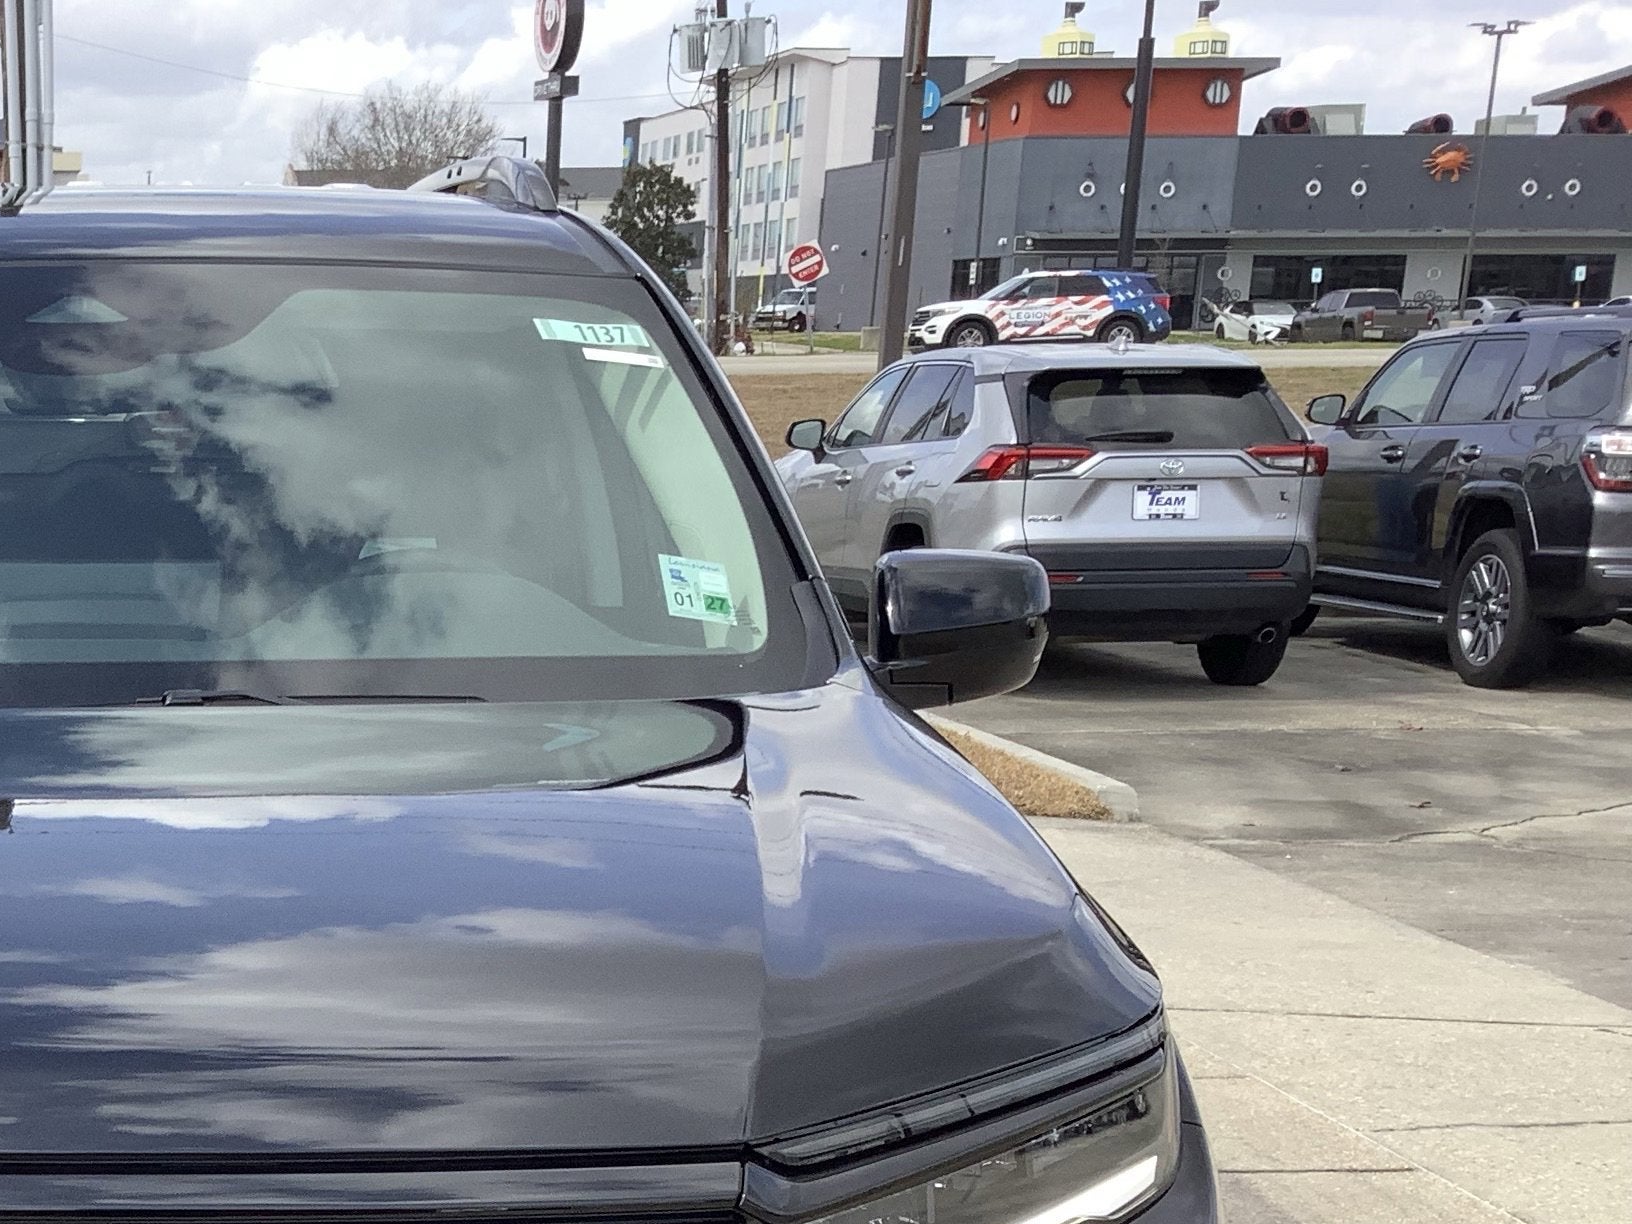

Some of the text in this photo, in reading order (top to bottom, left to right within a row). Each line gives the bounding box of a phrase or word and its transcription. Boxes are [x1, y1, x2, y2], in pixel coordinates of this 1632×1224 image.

[791, 248, 815, 264] DO NOT
[798, 264, 820, 278] ENTER
[1008, 311, 1051, 320] LEGION
[573, 324, 625, 343] 1137
[1148, 490, 1186, 506] TEAM
[674, 592, 725, 610] 01 27
